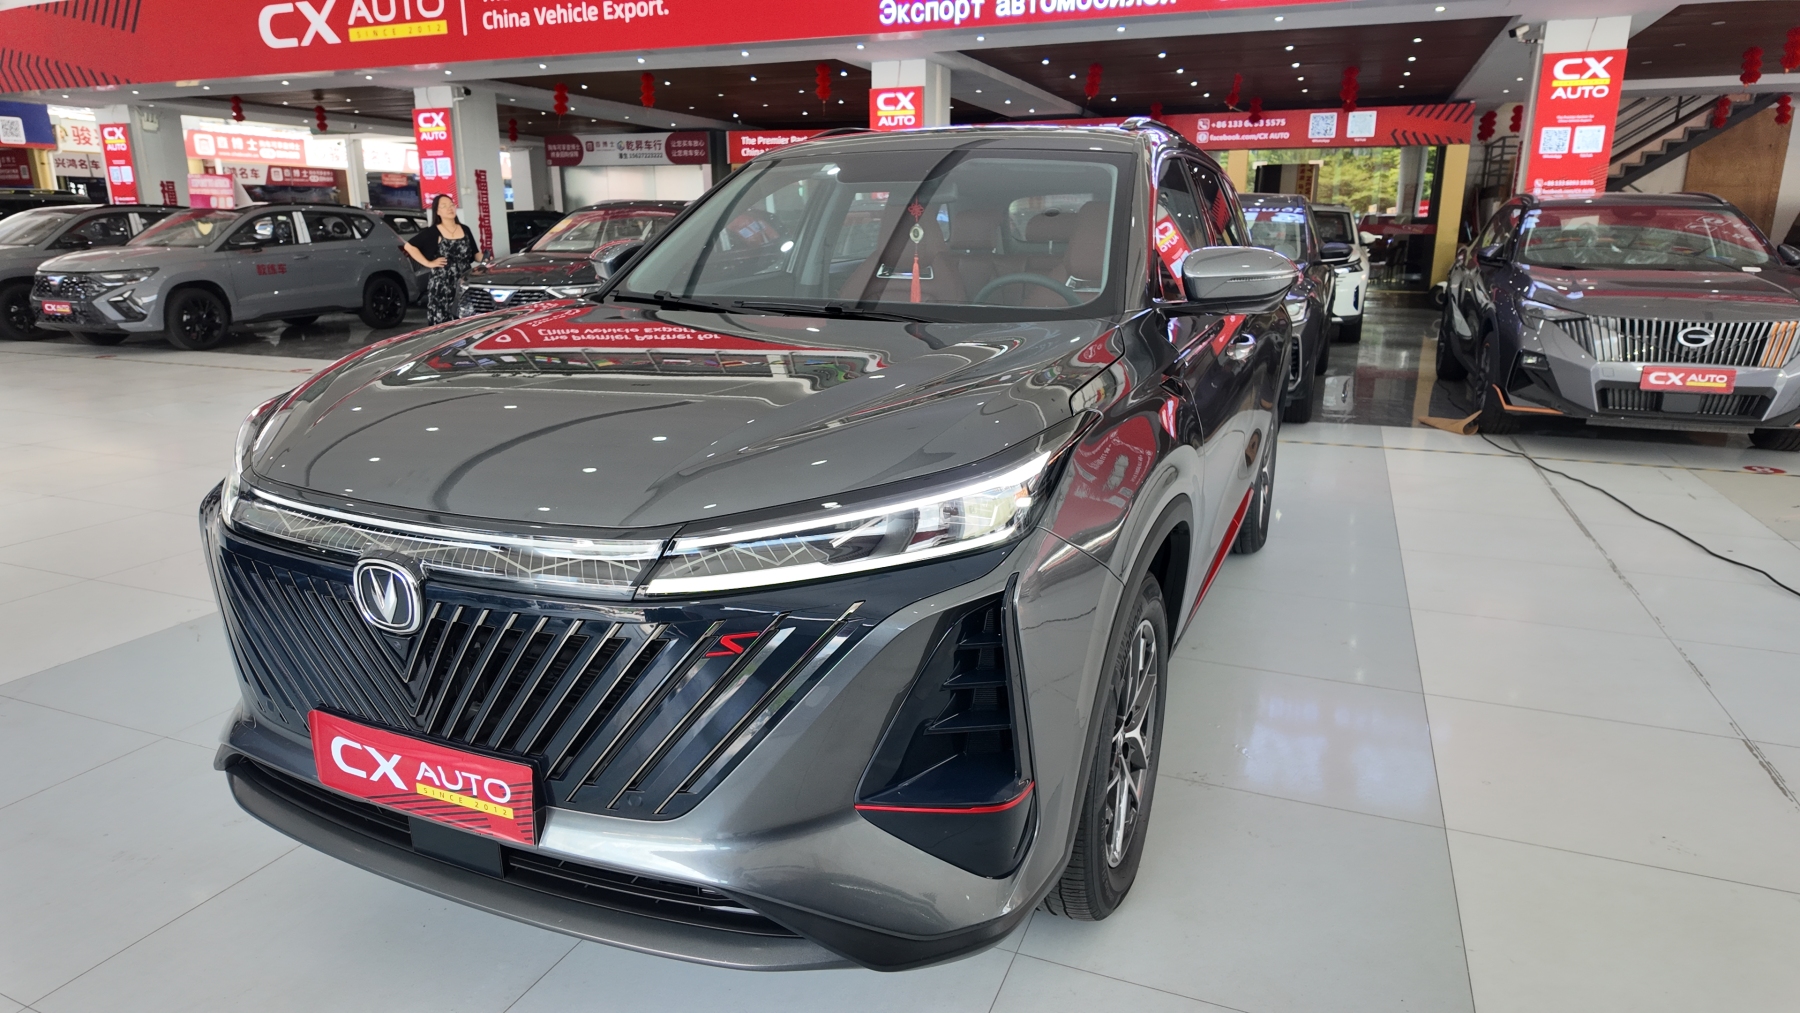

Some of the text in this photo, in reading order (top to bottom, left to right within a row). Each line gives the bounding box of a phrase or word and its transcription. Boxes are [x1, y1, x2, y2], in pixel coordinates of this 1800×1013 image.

[482, 0, 670, 30] China Vehicle Export.
[879, 0, 986, 26] Экспорт
[258, 0, 445, 49] CX AUTO
[356, 24, 441, 39] SINCE 2012
[1553, 56, 1614, 80] CX
[1550, 85, 1610, 100] AUTO
[876, 91, 916, 110] CX
[418, 112, 445, 128] CX
[877, 115, 916, 126] AUTO
[1265, 118, 1286, 127] 5575
[103, 126, 125, 141] CX
[420, 131, 447, 141] AUTO
[741, 136, 757, 145] The
[757, 136, 790, 145] Premier
[106, 143, 127, 151] AUTO
[45, 303, 57, 311] CX
[1649, 371, 1728, 386] CX AUTO
[330, 735, 512, 804] CX AUTO
[423, 787, 508, 816] SINCE 2012
